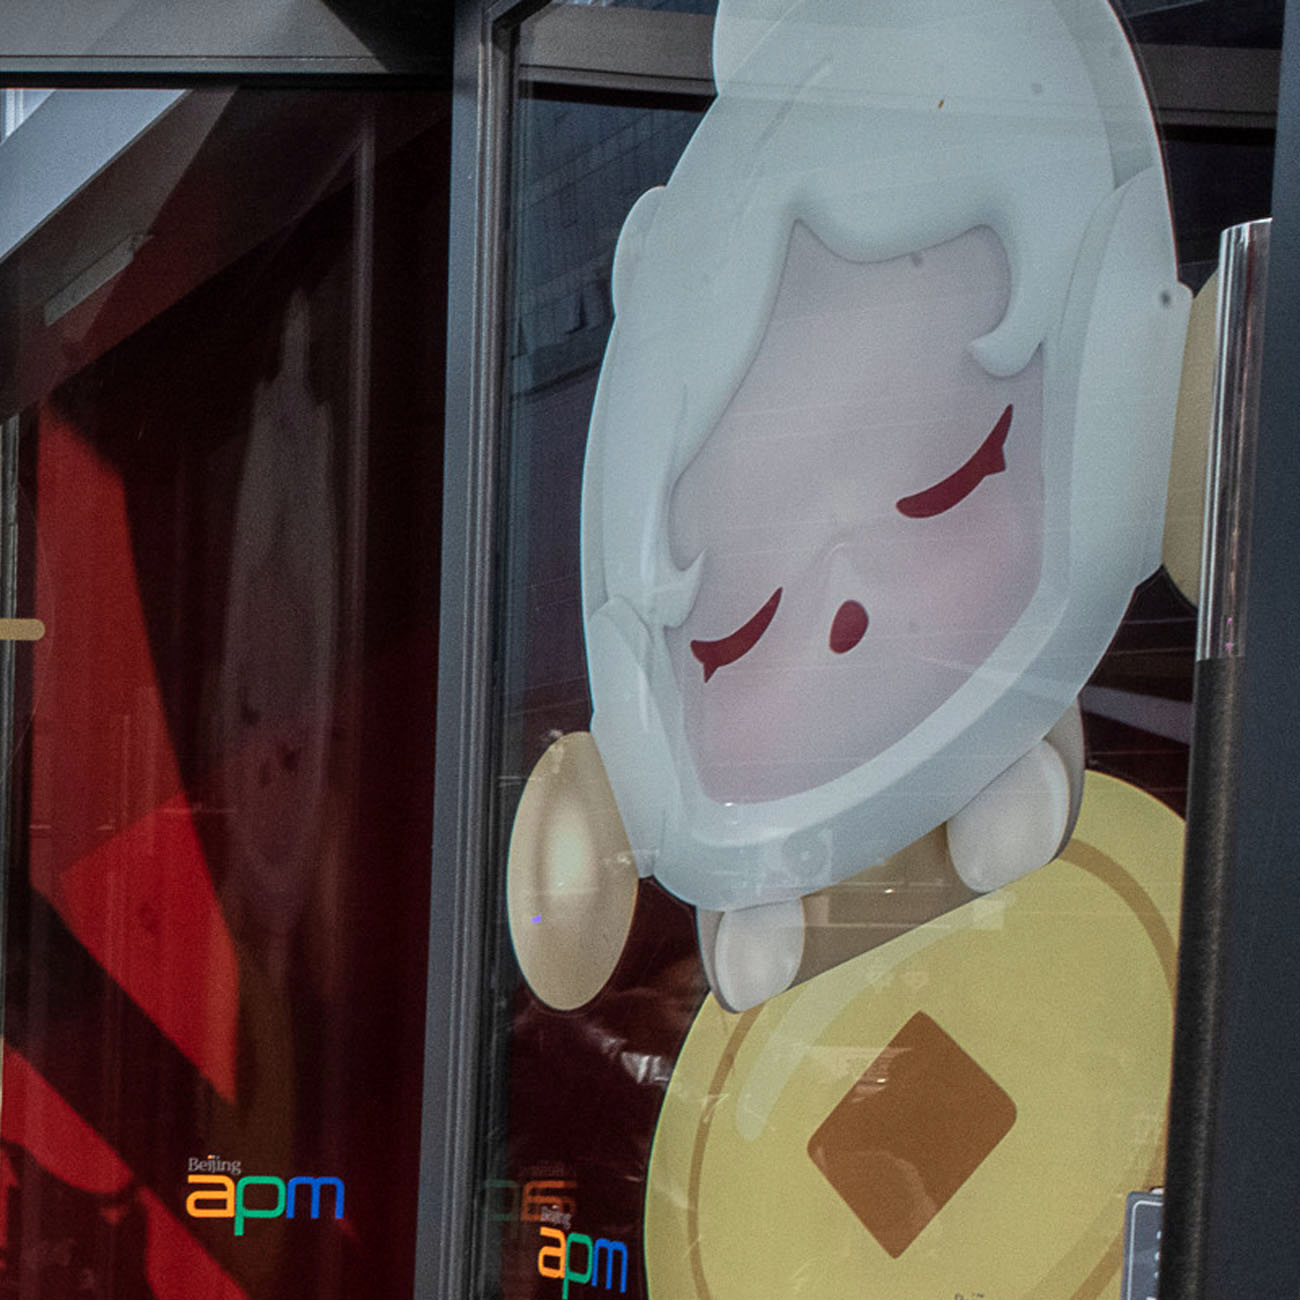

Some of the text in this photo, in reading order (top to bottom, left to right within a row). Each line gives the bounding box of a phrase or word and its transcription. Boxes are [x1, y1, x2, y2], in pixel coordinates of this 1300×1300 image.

[188, 1154, 242, 1175] Beijing
[185, 1174, 345, 1236] apm
[538, 1227, 628, 1300] apm
